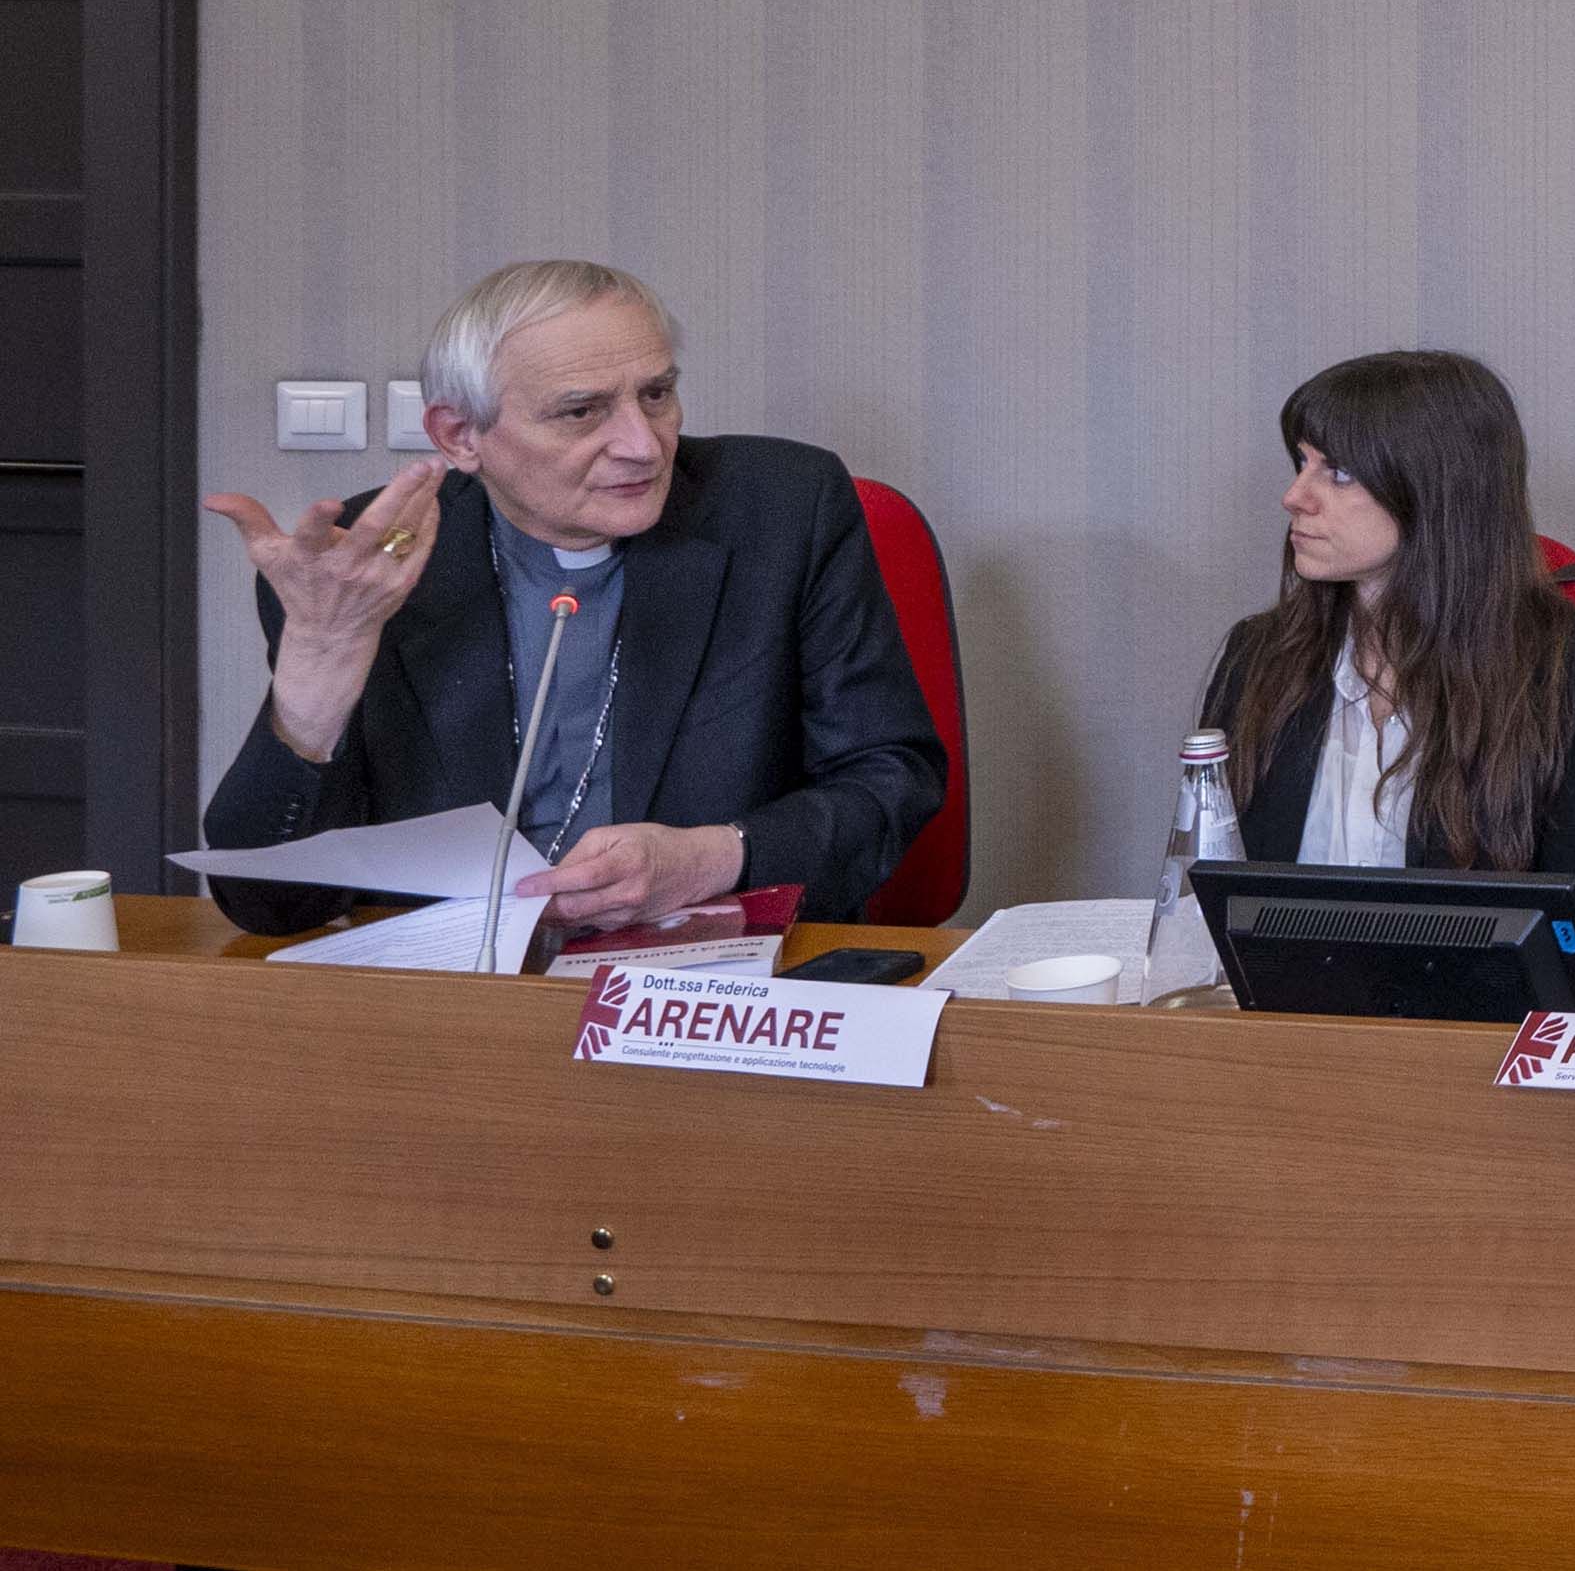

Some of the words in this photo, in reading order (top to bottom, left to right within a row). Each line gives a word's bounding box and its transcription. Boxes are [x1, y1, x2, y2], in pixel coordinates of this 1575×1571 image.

[643, 974, 702, 993] Dott.ssa
[706, 980, 769, 998] Federica
[622, 997, 845, 1051] ARENARE
[621, 1045, 671, 1058] Consulente
[672, 1052, 733, 1065] progettazione
[742, 1057, 798, 1069] applicazione
[800, 1060, 846, 1073] tecnologie
